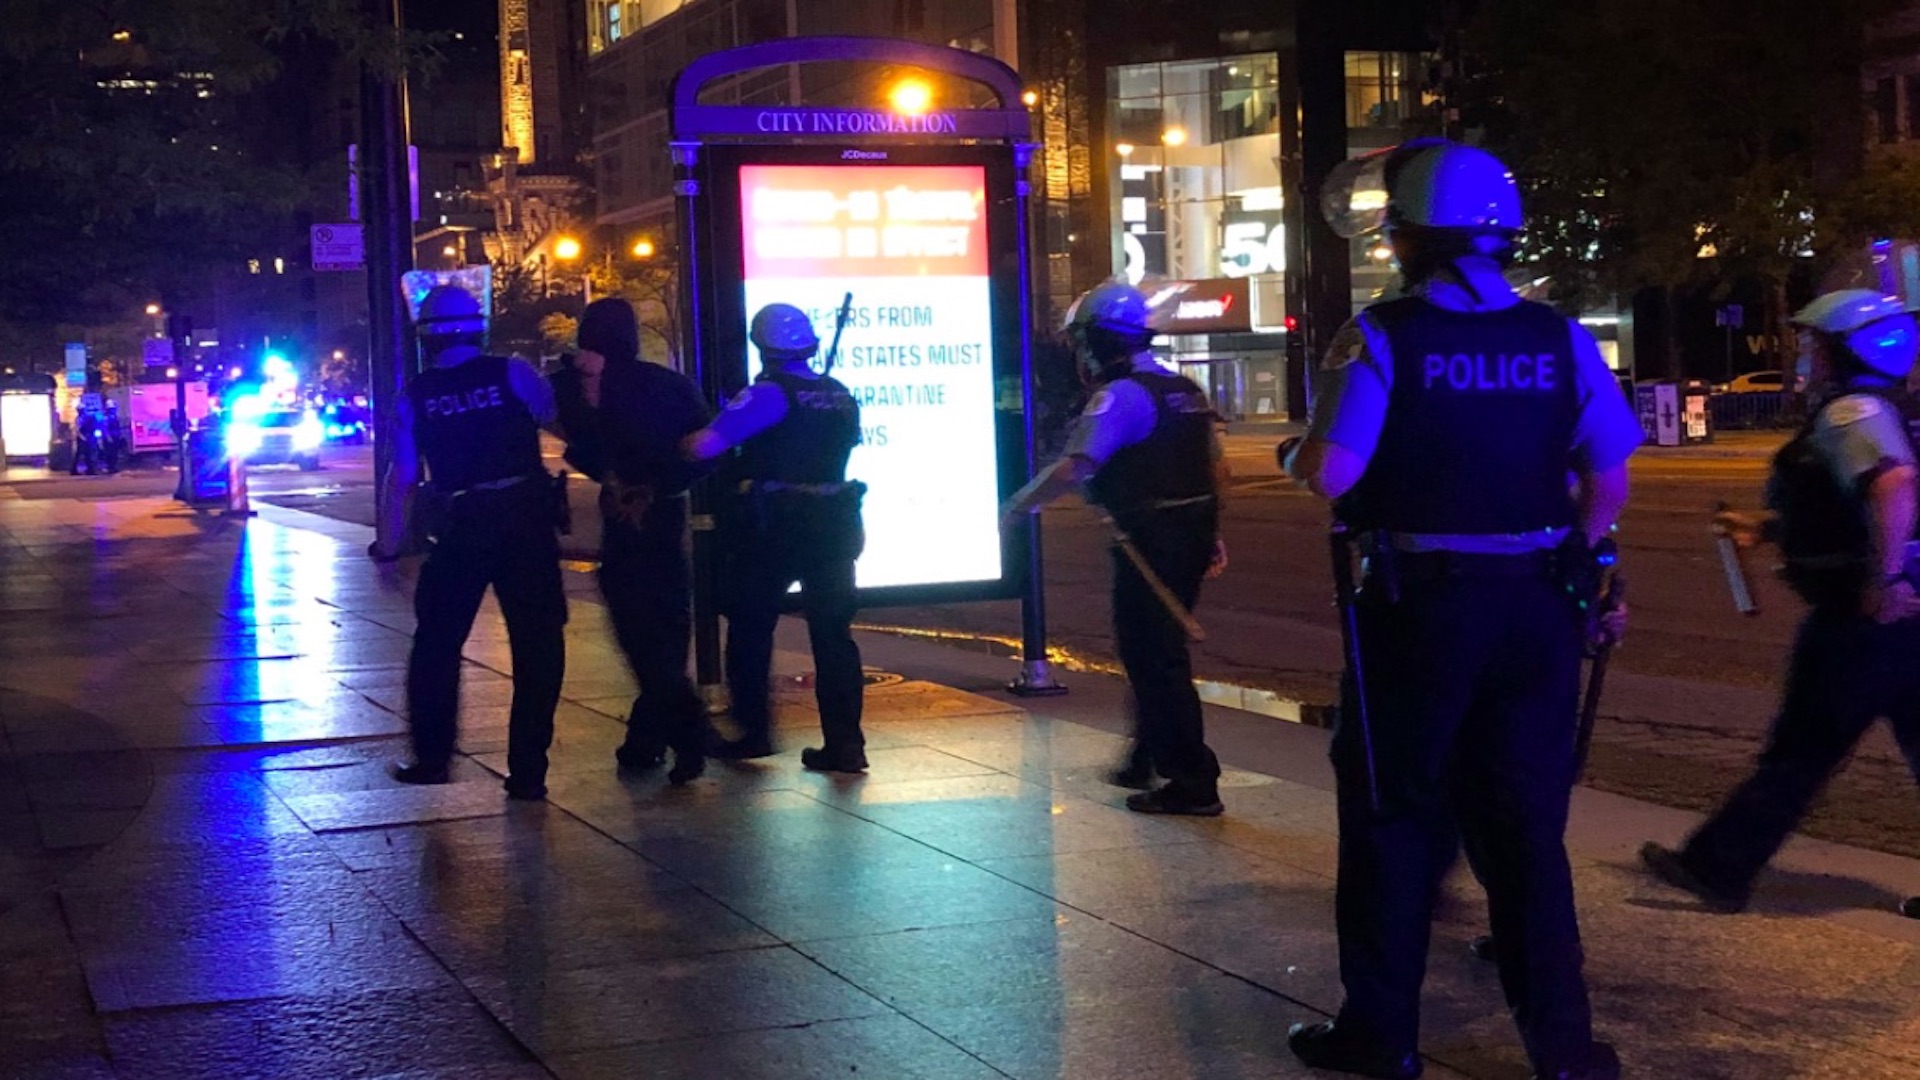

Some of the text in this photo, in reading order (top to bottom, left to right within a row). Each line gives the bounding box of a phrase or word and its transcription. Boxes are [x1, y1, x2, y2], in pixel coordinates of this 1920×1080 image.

[757, 112, 957, 133] CITY INFORMATION
[877, 305, 933, 328] FROM
[852, 344, 921, 368] STATES
[928, 343, 982, 365] MUST
[1424, 354, 1555, 390] POLICE
[425, 386, 502, 418] POLICE
[852, 384, 946, 408] ARANTINE
